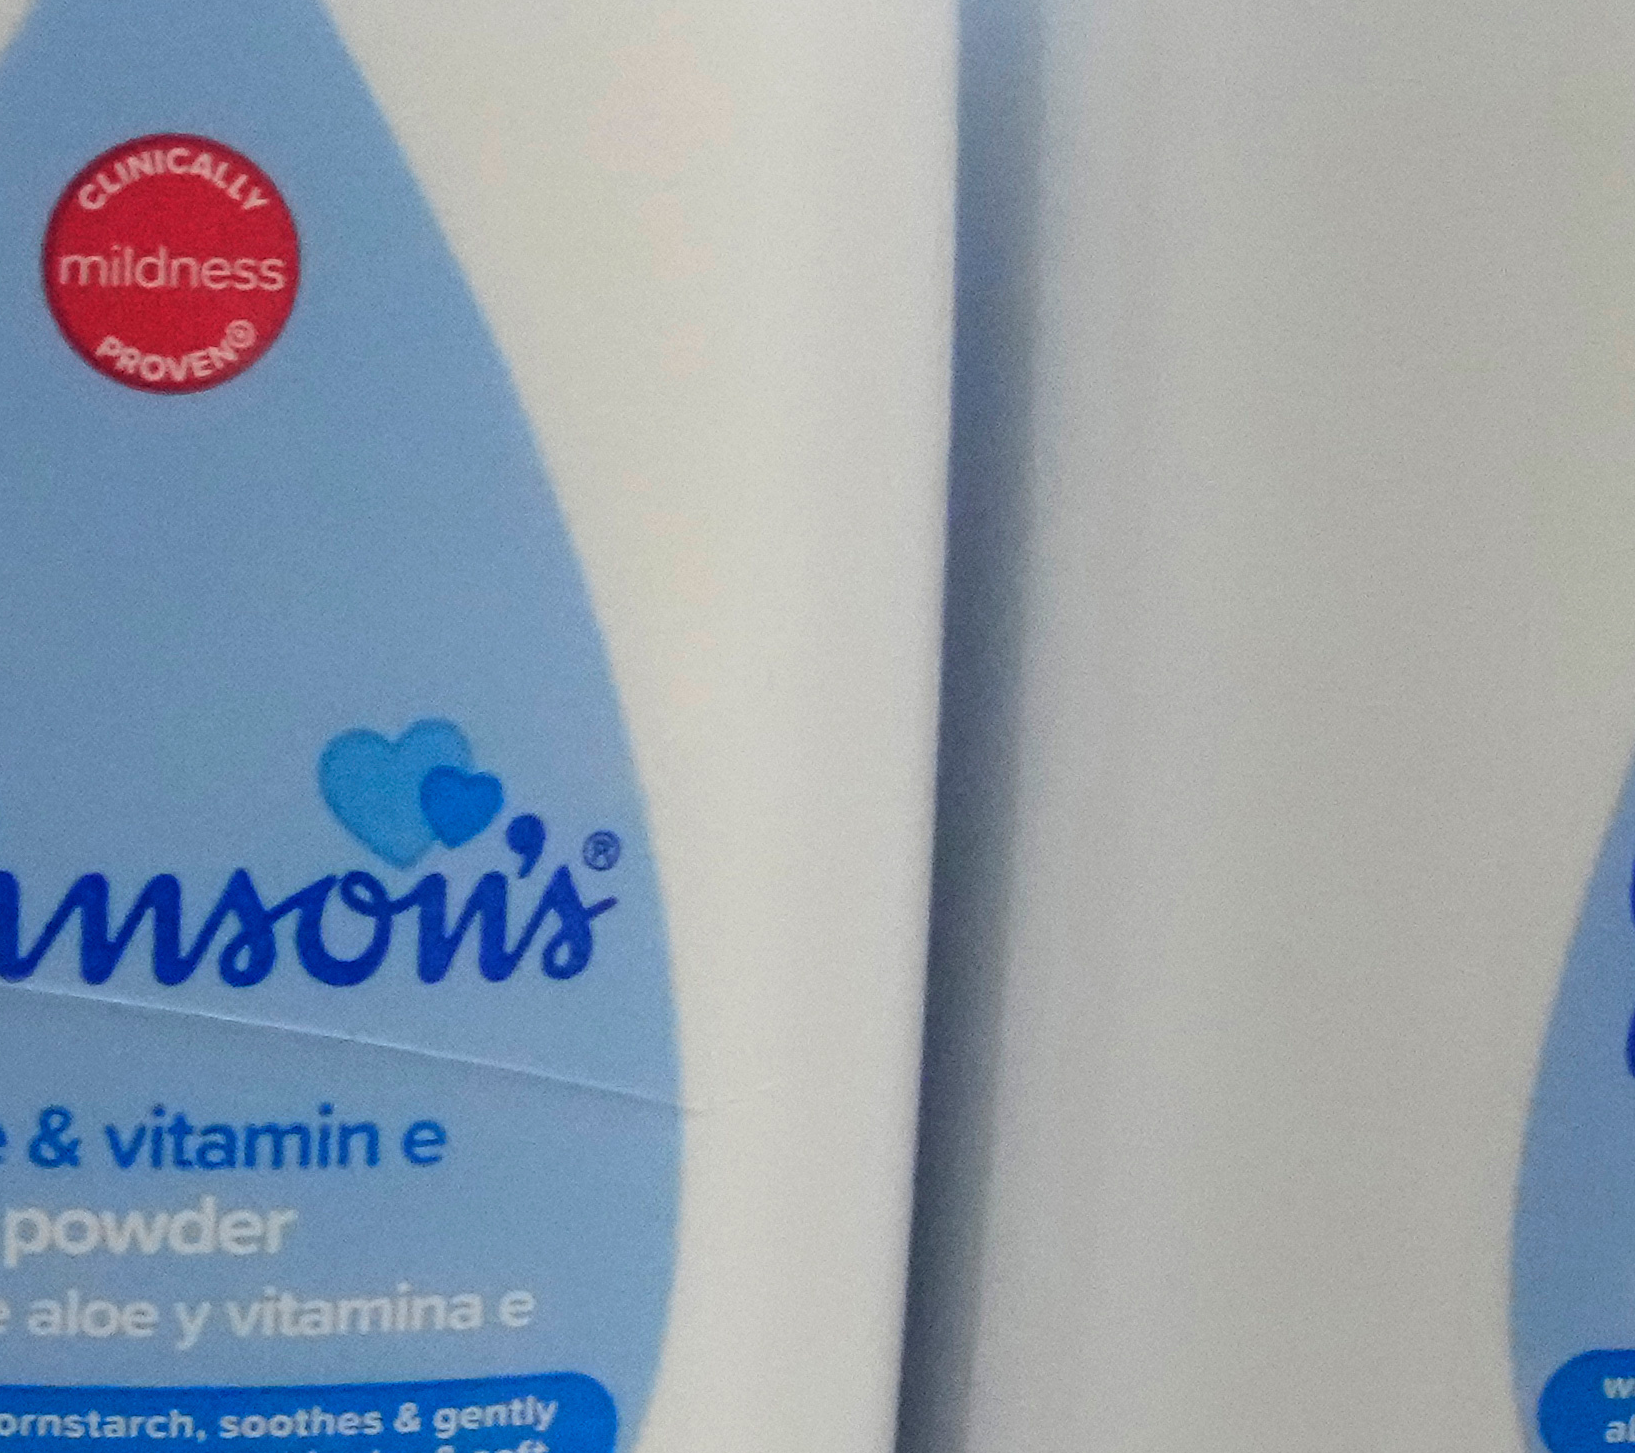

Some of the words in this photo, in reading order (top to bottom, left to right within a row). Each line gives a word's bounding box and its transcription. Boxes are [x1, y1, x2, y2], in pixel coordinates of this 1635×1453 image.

[78, 147, 269, 211] CLINICALLY
[59, 245, 285, 291] mildness
[105, 1103, 382, 1173] vitamin
[2, 1194, 297, 1268] powder
[26, 1286, 159, 1339] aloe
[225, 1282, 486, 1339] vitamina
[219, 1402, 383, 1439] soothes
[433, 1394, 560, 1439] gently
